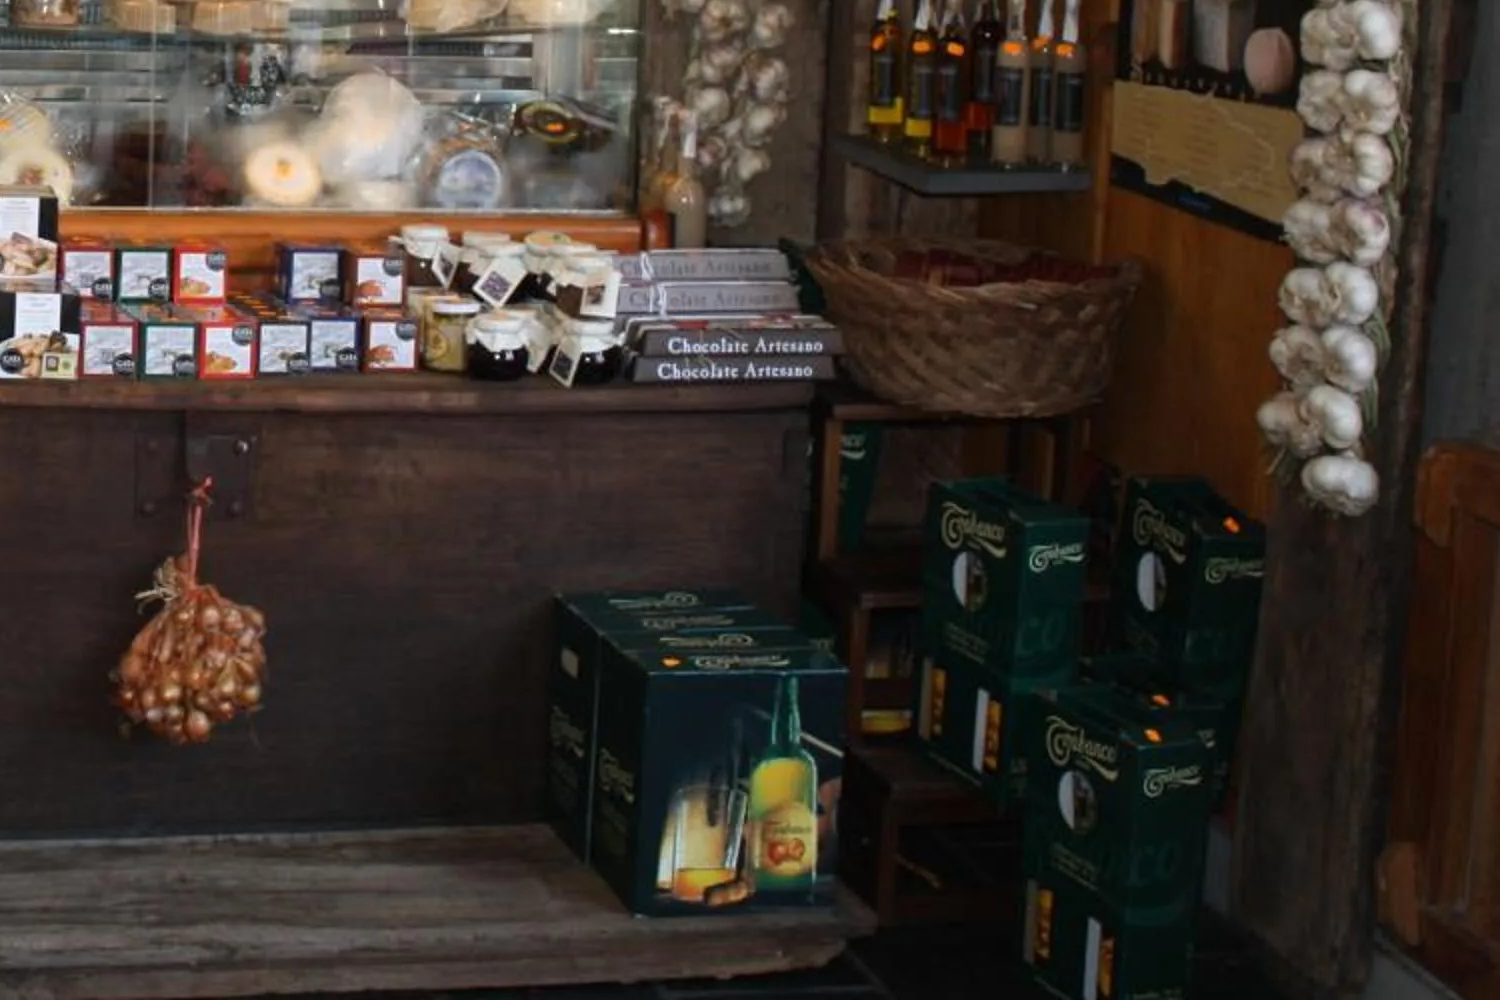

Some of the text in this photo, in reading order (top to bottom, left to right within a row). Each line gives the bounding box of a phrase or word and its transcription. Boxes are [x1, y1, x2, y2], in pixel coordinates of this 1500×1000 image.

[619, 258, 697, 276] Chcolate
[629, 290, 708, 307] Choolate
[667, 337, 824, 355] Chocolate Artesano
[657, 362, 813, 381] Chocolate Artesano
